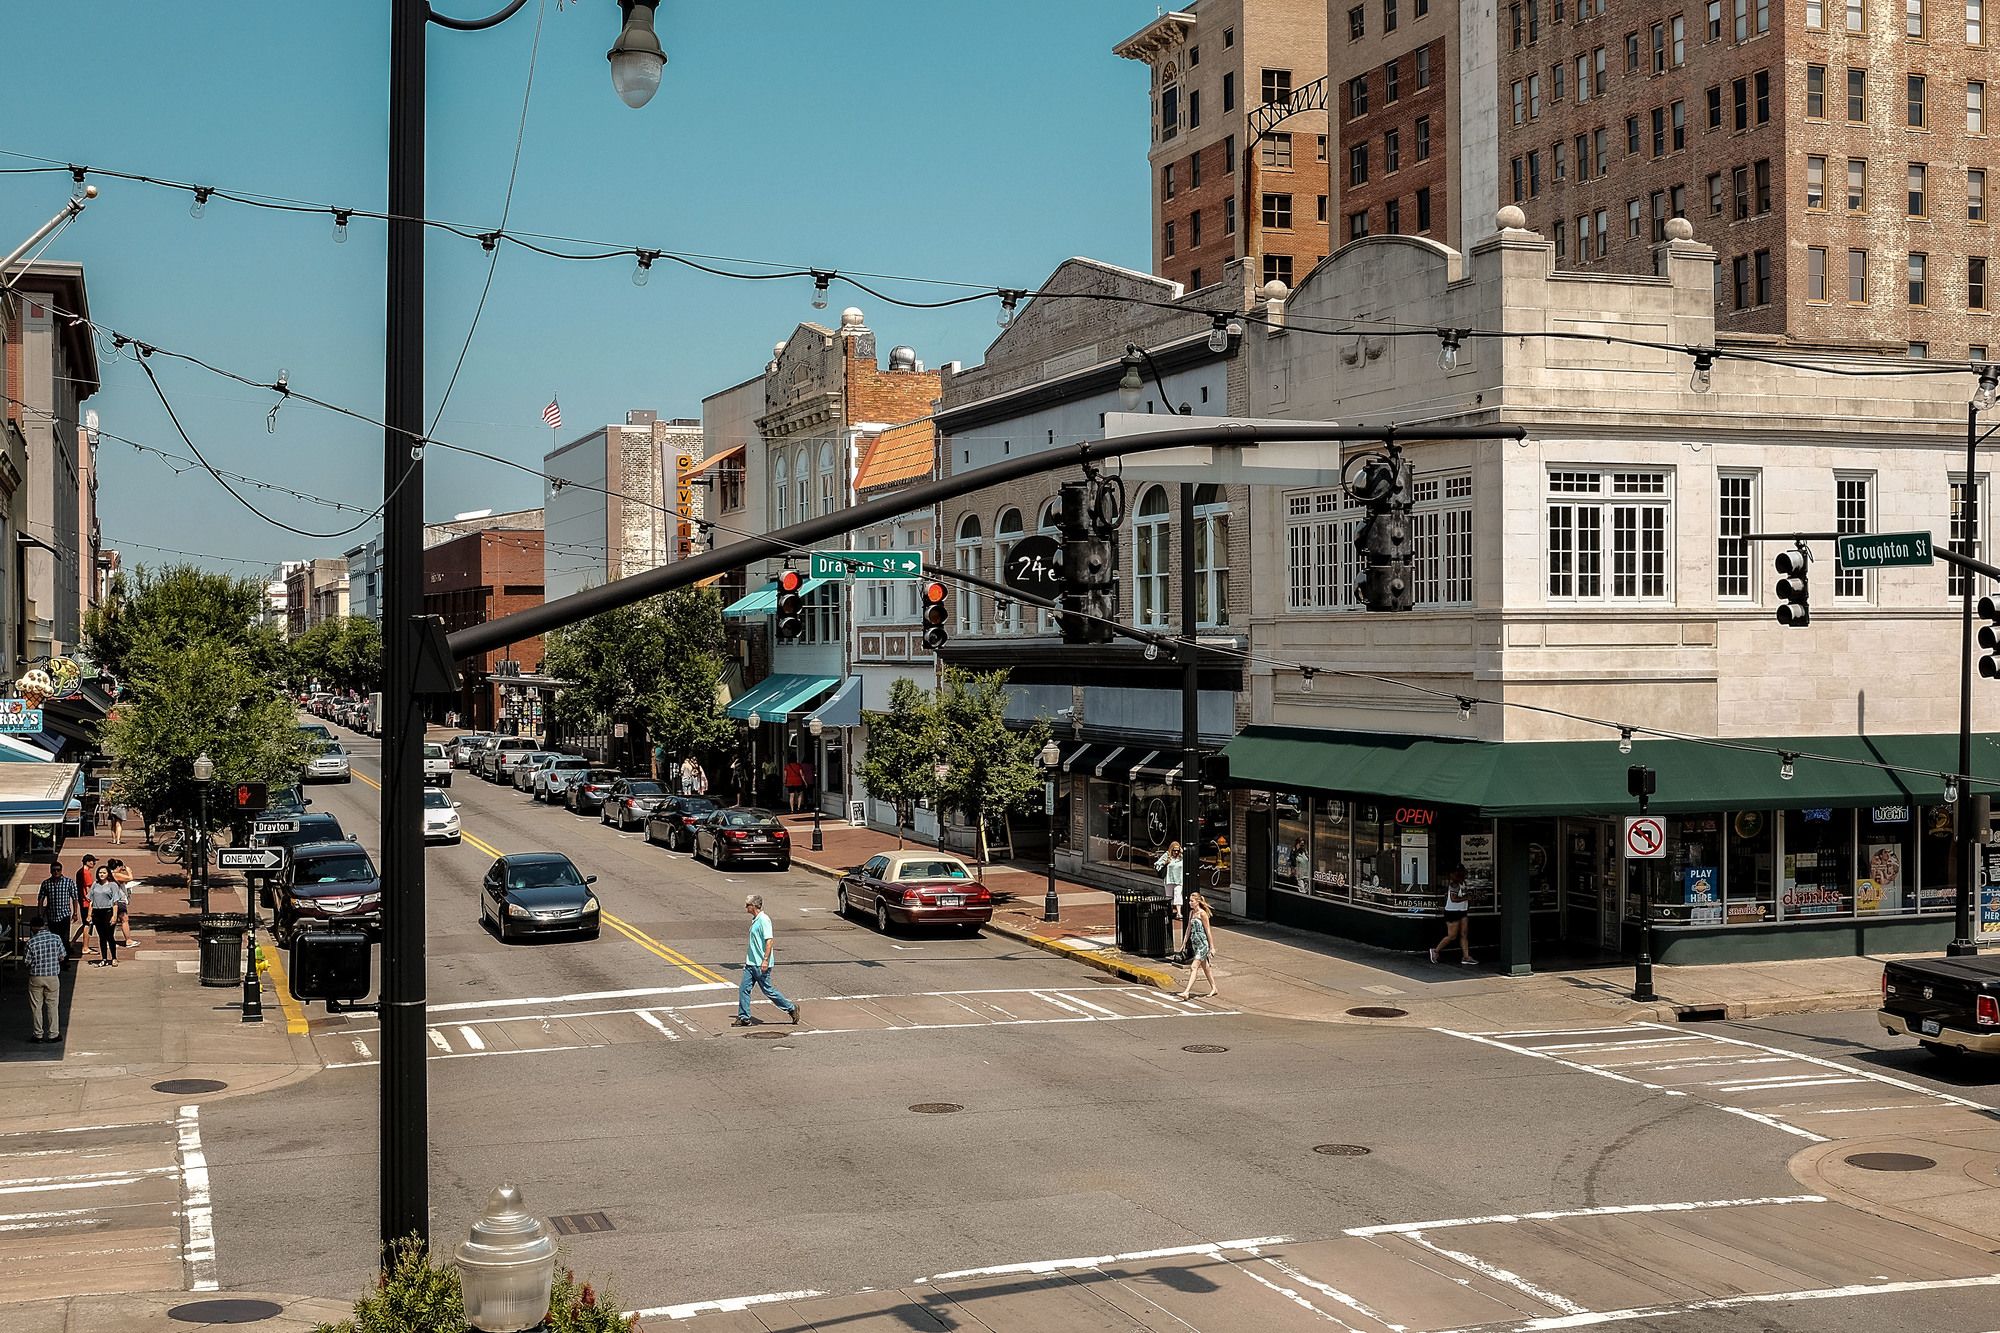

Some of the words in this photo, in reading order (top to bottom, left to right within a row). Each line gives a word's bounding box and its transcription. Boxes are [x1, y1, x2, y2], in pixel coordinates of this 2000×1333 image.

[1847, 541, 1909, 564] Broughton
[1915, 539, 1927, 557] St
[882, 558, 896, 573] St
[1395, 808, 1434, 825] OPEN
[1874, 808, 1907, 821] LIGHT
[259, 822, 290, 832] Drayton
[225, 854, 243, 863] ONE
[246, 854, 264, 863] WAY
[1690, 869, 1712, 878] PLAY
[1690, 893, 1712, 903] HERE
[1783, 885, 1840, 906] drinks
[1393, 898, 1439, 908] LANDSHARK
